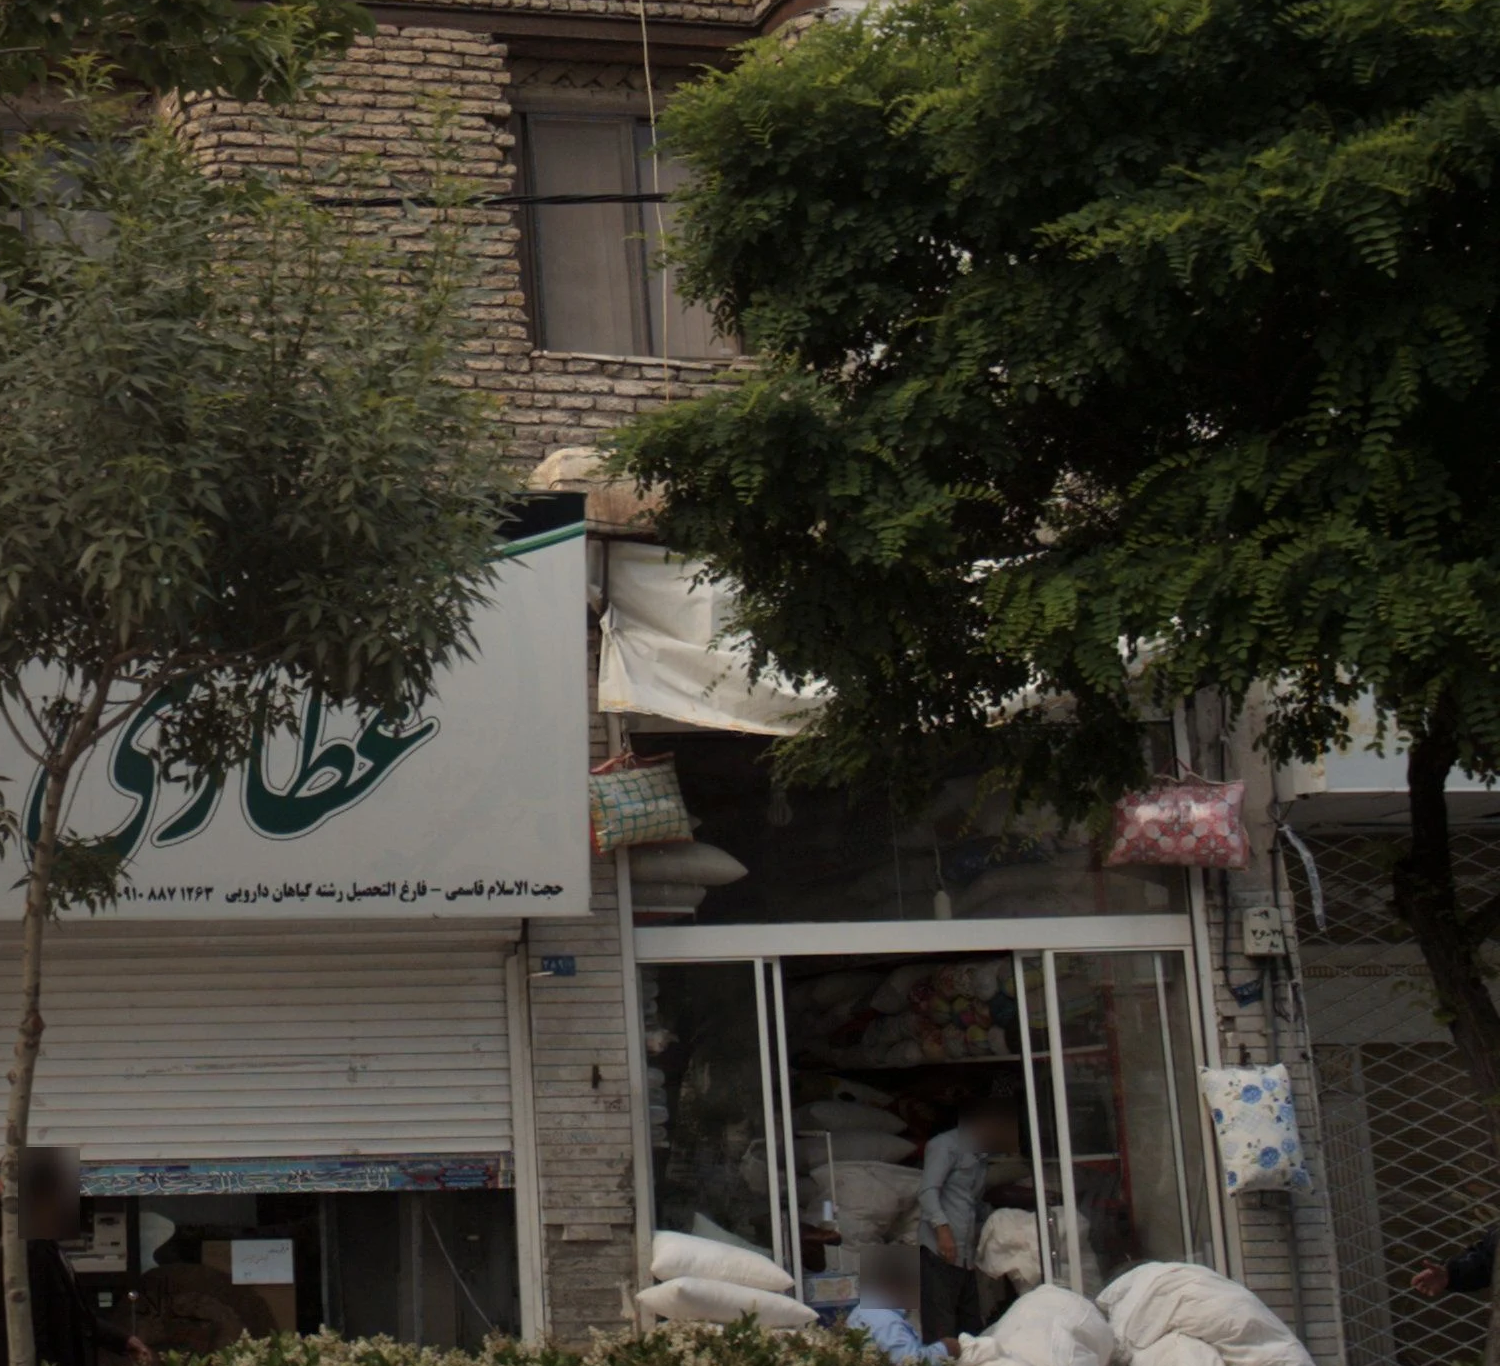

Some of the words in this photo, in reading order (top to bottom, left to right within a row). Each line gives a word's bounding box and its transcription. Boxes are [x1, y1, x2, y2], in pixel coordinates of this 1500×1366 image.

[147, 886, 177, 902] ۸۸۷
[225, 882, 269, 903] دارویی
[272, 882, 313, 902] گیاهان
[316, 882, 344, 903] رشته
[347, 880, 396, 902] التحصیل
[399, 879, 428, 902] فارغ
[445, 880, 484, 901] قاسمی
[487, 880, 529, 900] الاسلام
[531, 882, 564, 900] حجت
